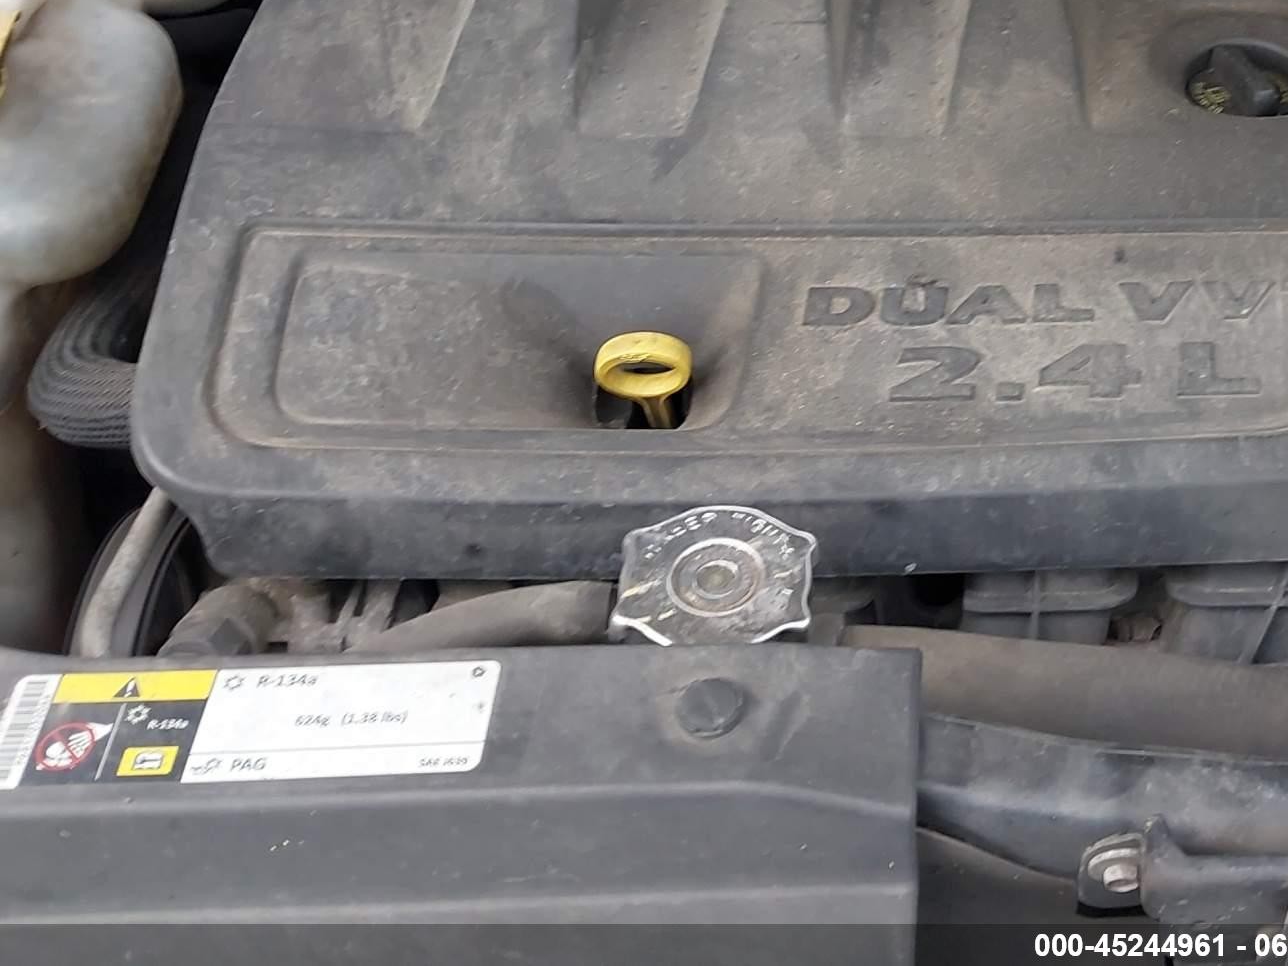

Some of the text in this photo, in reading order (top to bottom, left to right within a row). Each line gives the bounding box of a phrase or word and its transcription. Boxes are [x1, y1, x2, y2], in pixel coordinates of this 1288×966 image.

[802, 283, 1096, 327] DUAL
[256, 673, 319, 688] R-134a
[230, 757, 268, 772] PAG
